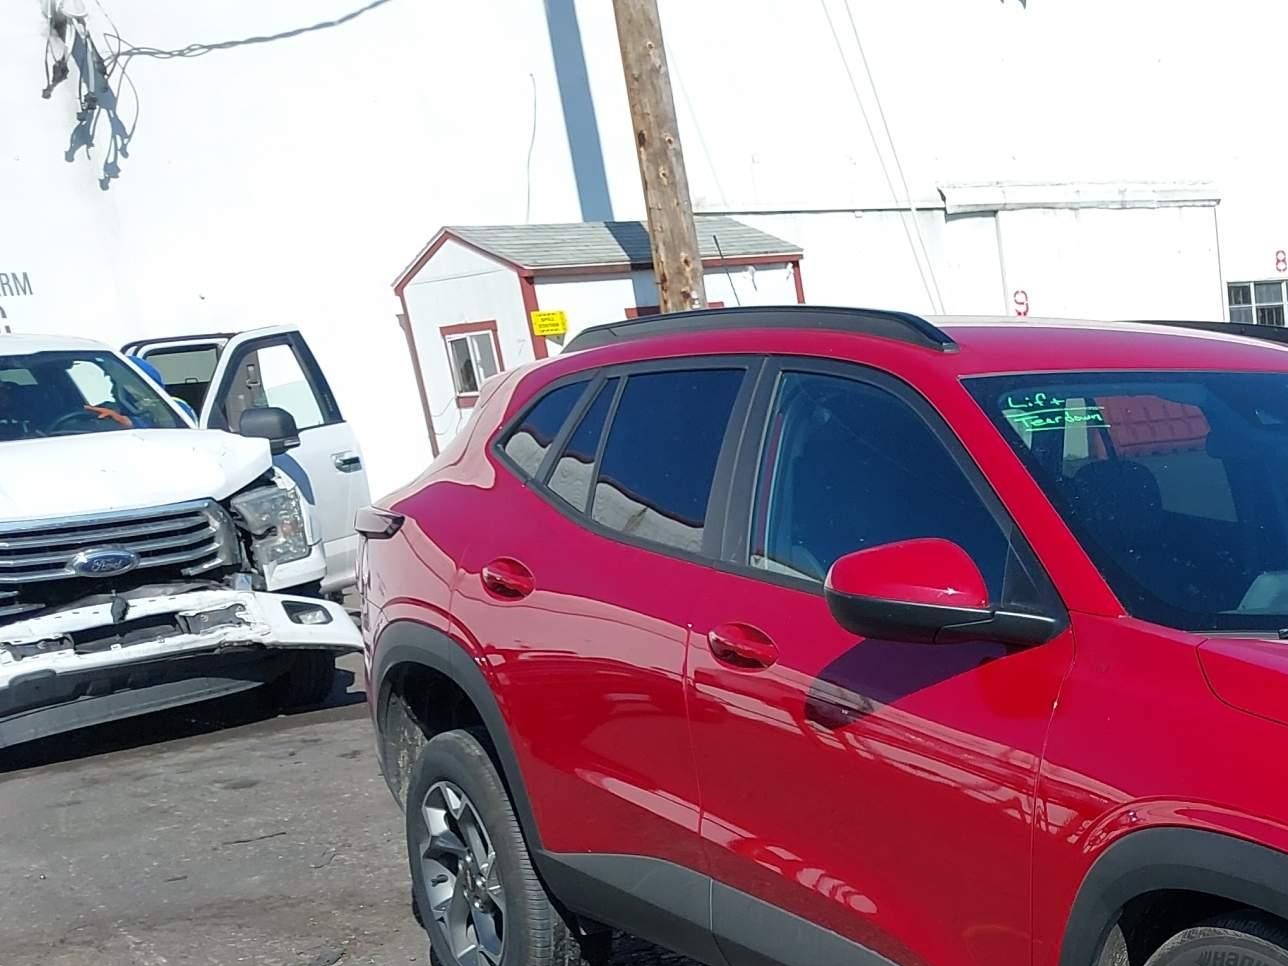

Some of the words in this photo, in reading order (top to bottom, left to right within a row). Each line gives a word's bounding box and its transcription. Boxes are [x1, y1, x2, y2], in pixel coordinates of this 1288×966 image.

[1275, 250, 1287, 272] 8
[0, 271, 33, 296] RM
[1013, 290, 1029, 316] 9
[1007, 393, 1065, 406] Lift
